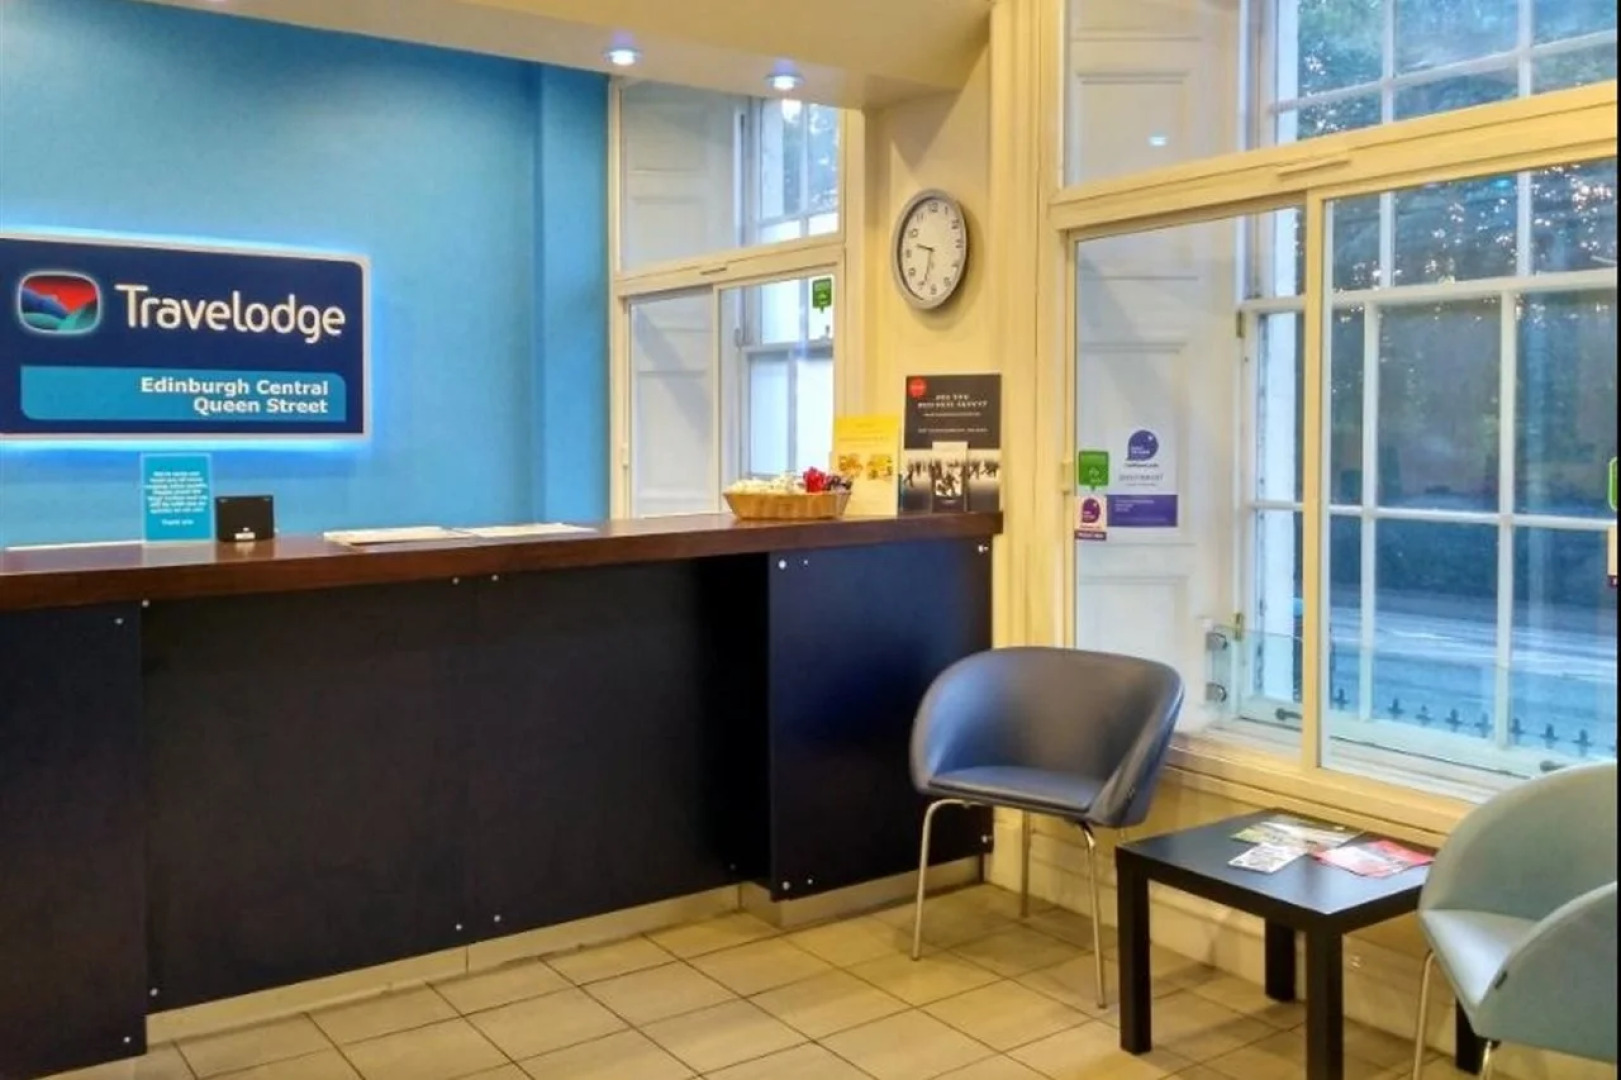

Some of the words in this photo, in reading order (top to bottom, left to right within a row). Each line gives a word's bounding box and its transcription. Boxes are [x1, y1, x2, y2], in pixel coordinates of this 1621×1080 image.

[114, 283, 346, 344] Travelodge
[140, 376, 250, 398] Edinburgh
[256, 379, 329, 396] Central
[193, 396, 261, 416] Queen
[266, 397, 329, 414] Street
